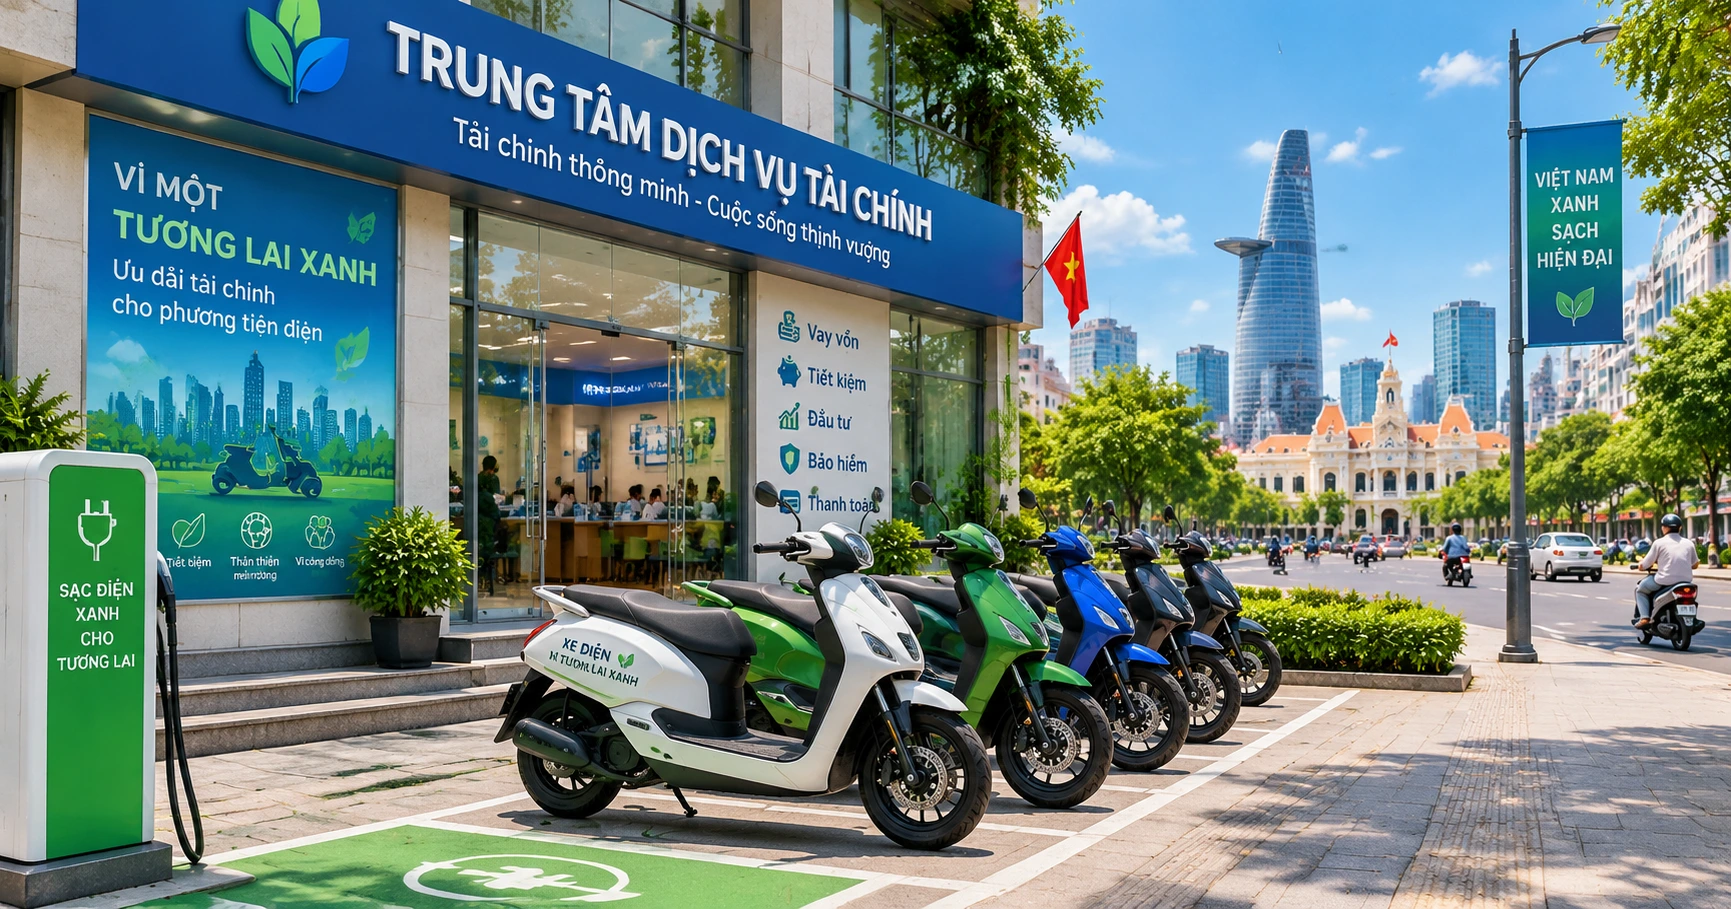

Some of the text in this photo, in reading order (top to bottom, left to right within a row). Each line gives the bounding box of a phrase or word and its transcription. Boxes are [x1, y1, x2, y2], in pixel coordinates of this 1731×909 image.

[386, 20, 932, 241] TRUNG TÂM DỊCH VỤ TÀI CHÍNH
[1534, 166, 1614, 191] VIỆT NAM
[156, 171, 223, 213] MỘT
[640, 177, 689, 208] minh
[800, 222, 841, 250] thịnh
[1550, 194, 1599, 214] XANH
[1551, 221, 1599, 244] SẠCH
[113, 208, 377, 287] TƯƠNG LAI XANH
[1537, 246, 1613, 272] HIỆN ĐẠI
[113, 258, 144, 283] Ưu
[112, 293, 153, 317] cho
[160, 300, 236, 335] phương
[241, 313, 278, 338] tiện
[807, 322, 833, 348] Vay
[837, 371, 866, 394] kiệm
[837, 414, 852, 431] tư
[808, 494, 847, 511] Thanh
[59, 583, 91, 602] SẠC
[75, 606, 119, 622] XANH
[80, 630, 114, 646] CHO
[562, 637, 578, 652] XE
[113, 653, 135, 668] LAI
[591, 663, 607, 677] LAI
[608, 669, 639, 687] XANH
